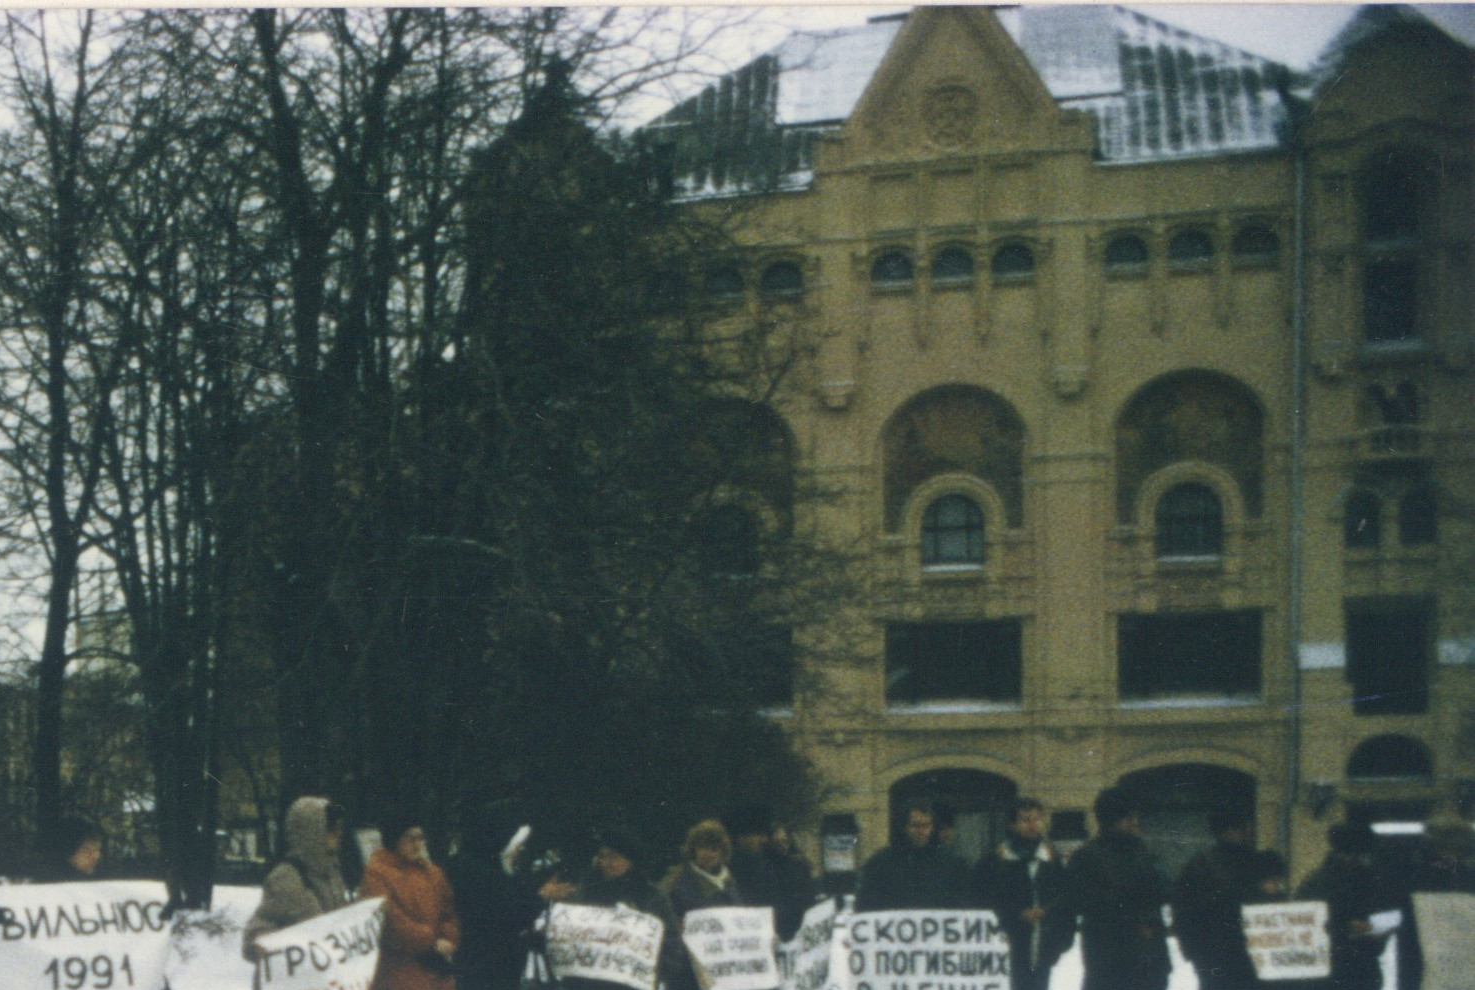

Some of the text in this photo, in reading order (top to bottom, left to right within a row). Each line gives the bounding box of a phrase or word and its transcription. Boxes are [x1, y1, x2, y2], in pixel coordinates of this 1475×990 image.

[0, 900, 166, 941] ВИЛЬНЮС
[849, 950, 1010, 976] О ПОГИБШИХ
